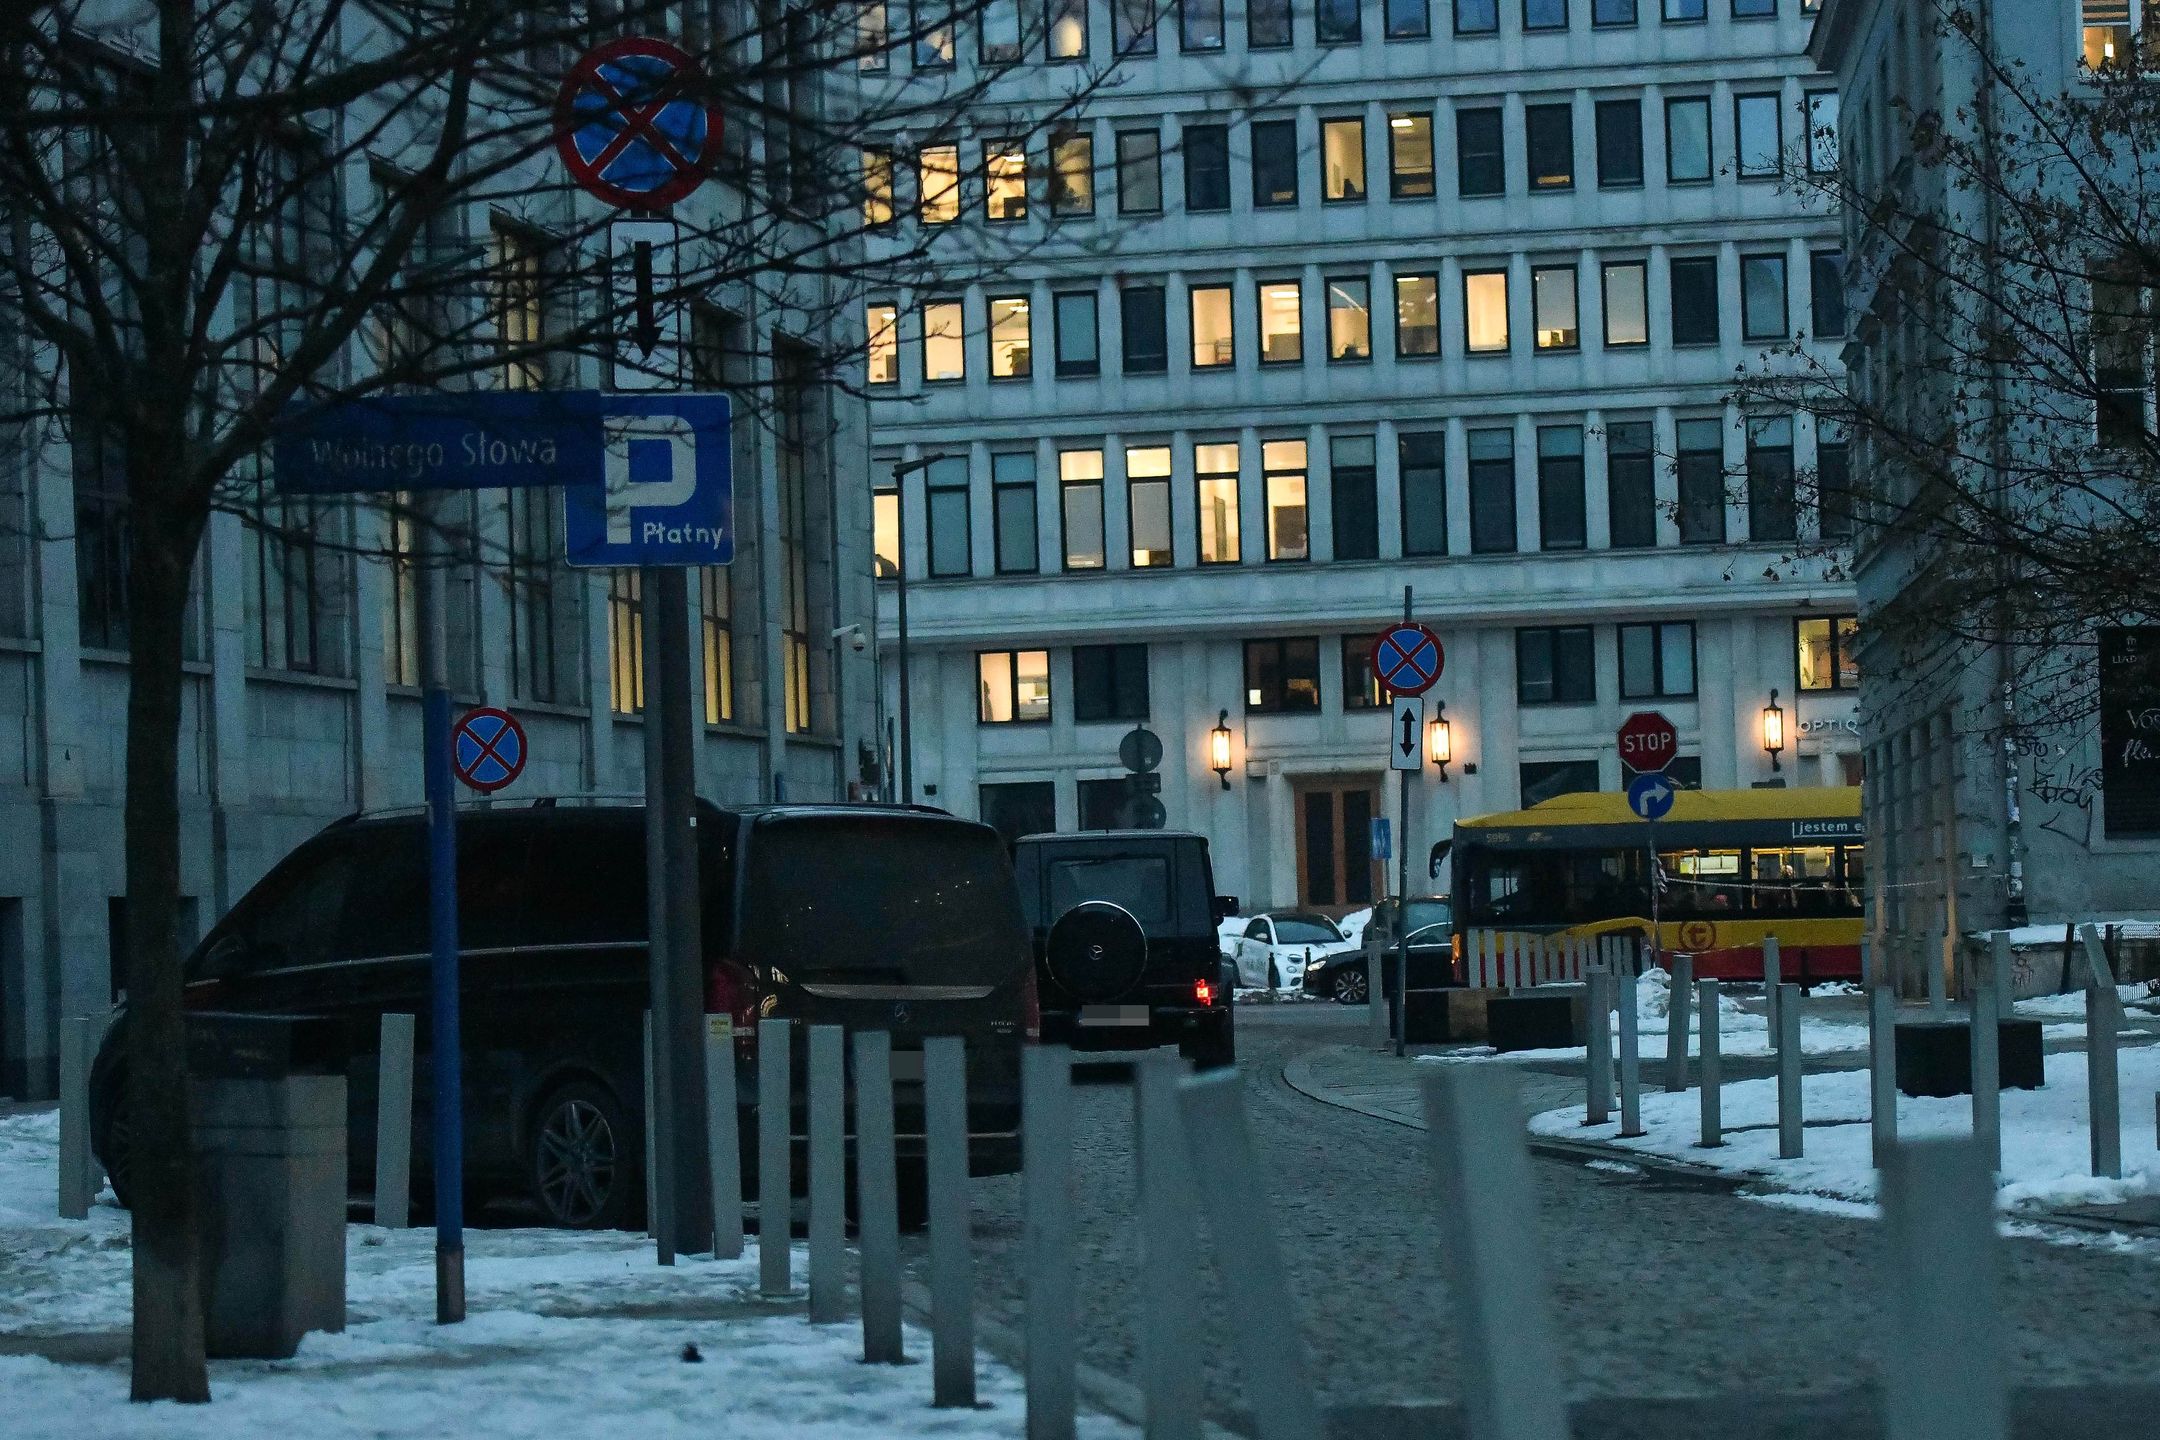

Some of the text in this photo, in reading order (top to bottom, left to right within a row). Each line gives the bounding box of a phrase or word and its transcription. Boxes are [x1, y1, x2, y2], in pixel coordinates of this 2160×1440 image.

[643, 521, 723, 550] Płatny
[1624, 732, 1671, 752] STOP
[1799, 821, 1848, 835] jestem
